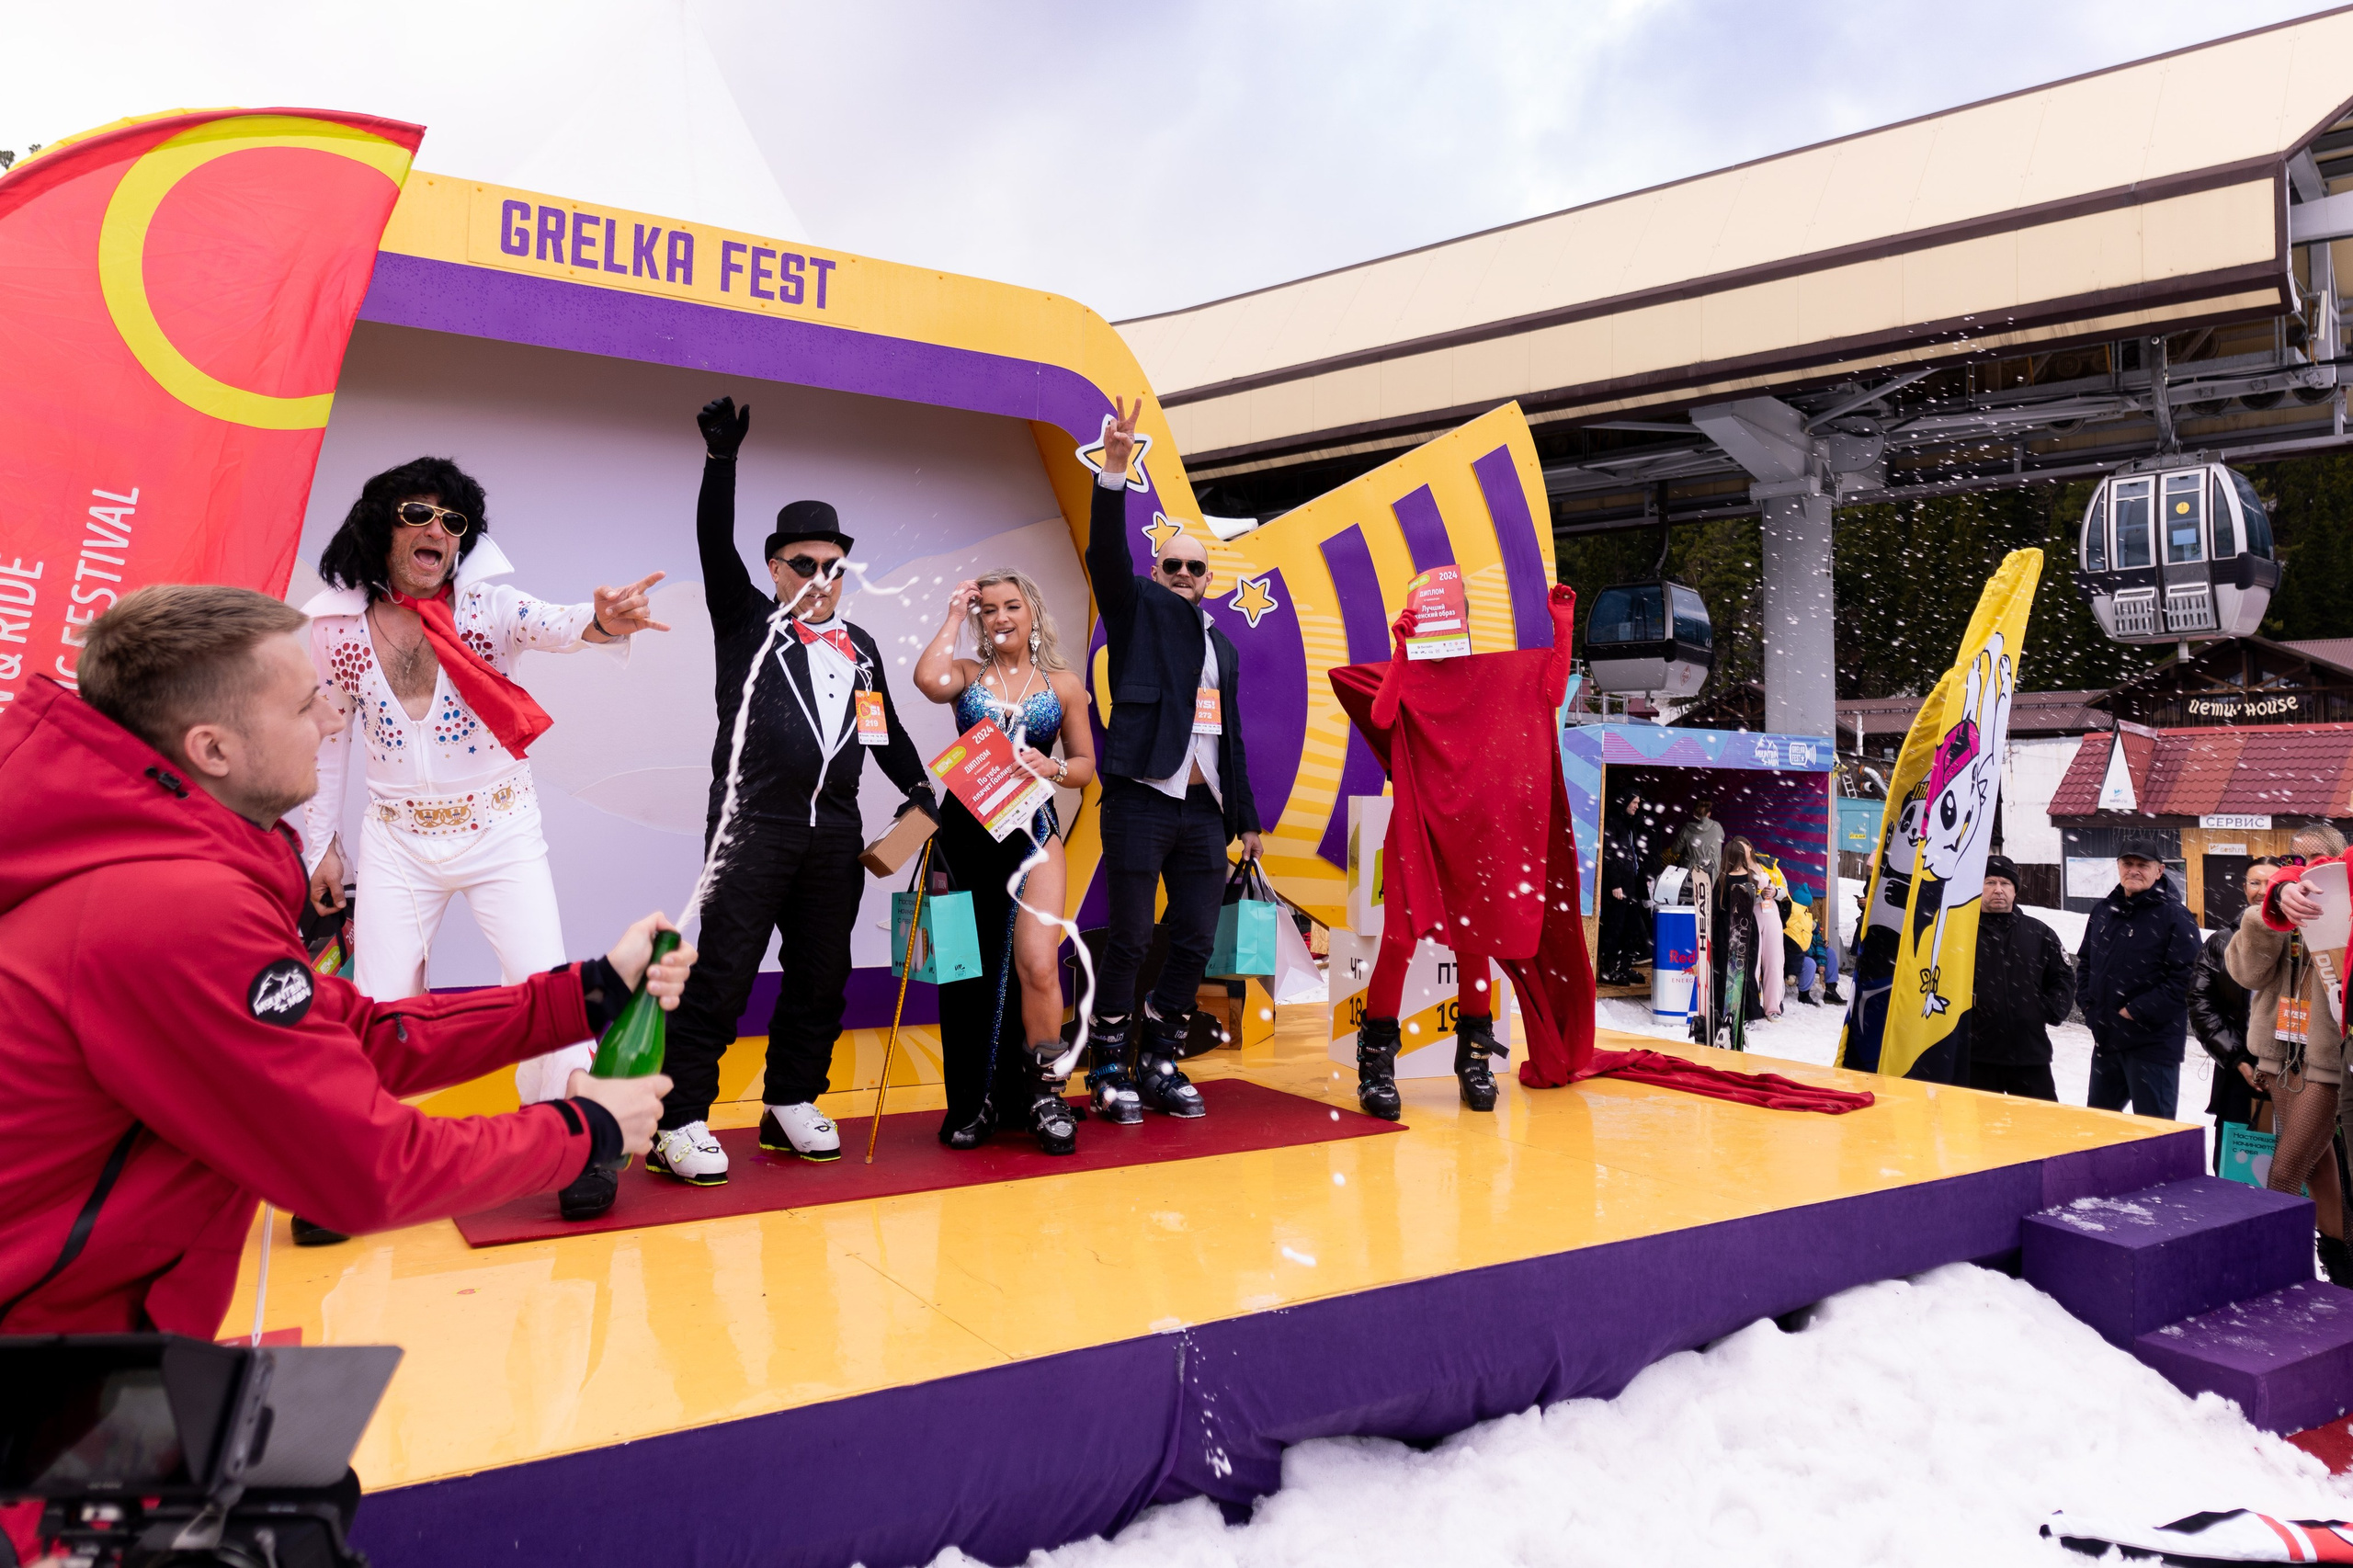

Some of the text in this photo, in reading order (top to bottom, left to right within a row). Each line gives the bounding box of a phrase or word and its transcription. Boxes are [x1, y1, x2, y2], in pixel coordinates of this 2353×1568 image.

[500, 199, 836, 310] GRELKA FEST
[1438, 571, 1458, 581] 2024
[0, 553, 44, 644] RIDE
[1419, 587, 1445, 597] ДИПЛОМ
[1421, 604, 1445, 613] Лучший
[1438, 610, 1456, 619] образ
[1198, 711, 1212, 720] 272
[972, 725, 995, 745] 2024
[964, 749, 992, 774] ДИПЛОМ
[976, 776, 989, 787] По
[986, 765, 1001, 779] тебе
[972, 782, 994, 802] плачет
[2206, 816, 2265, 828] СЕРВИС
[1699, 881, 1707, 952] HEAD
[1669, 949, 1696, 963] Red
[1349, 996, 1363, 1028] 18
[1437, 1001, 1461, 1033] 19
